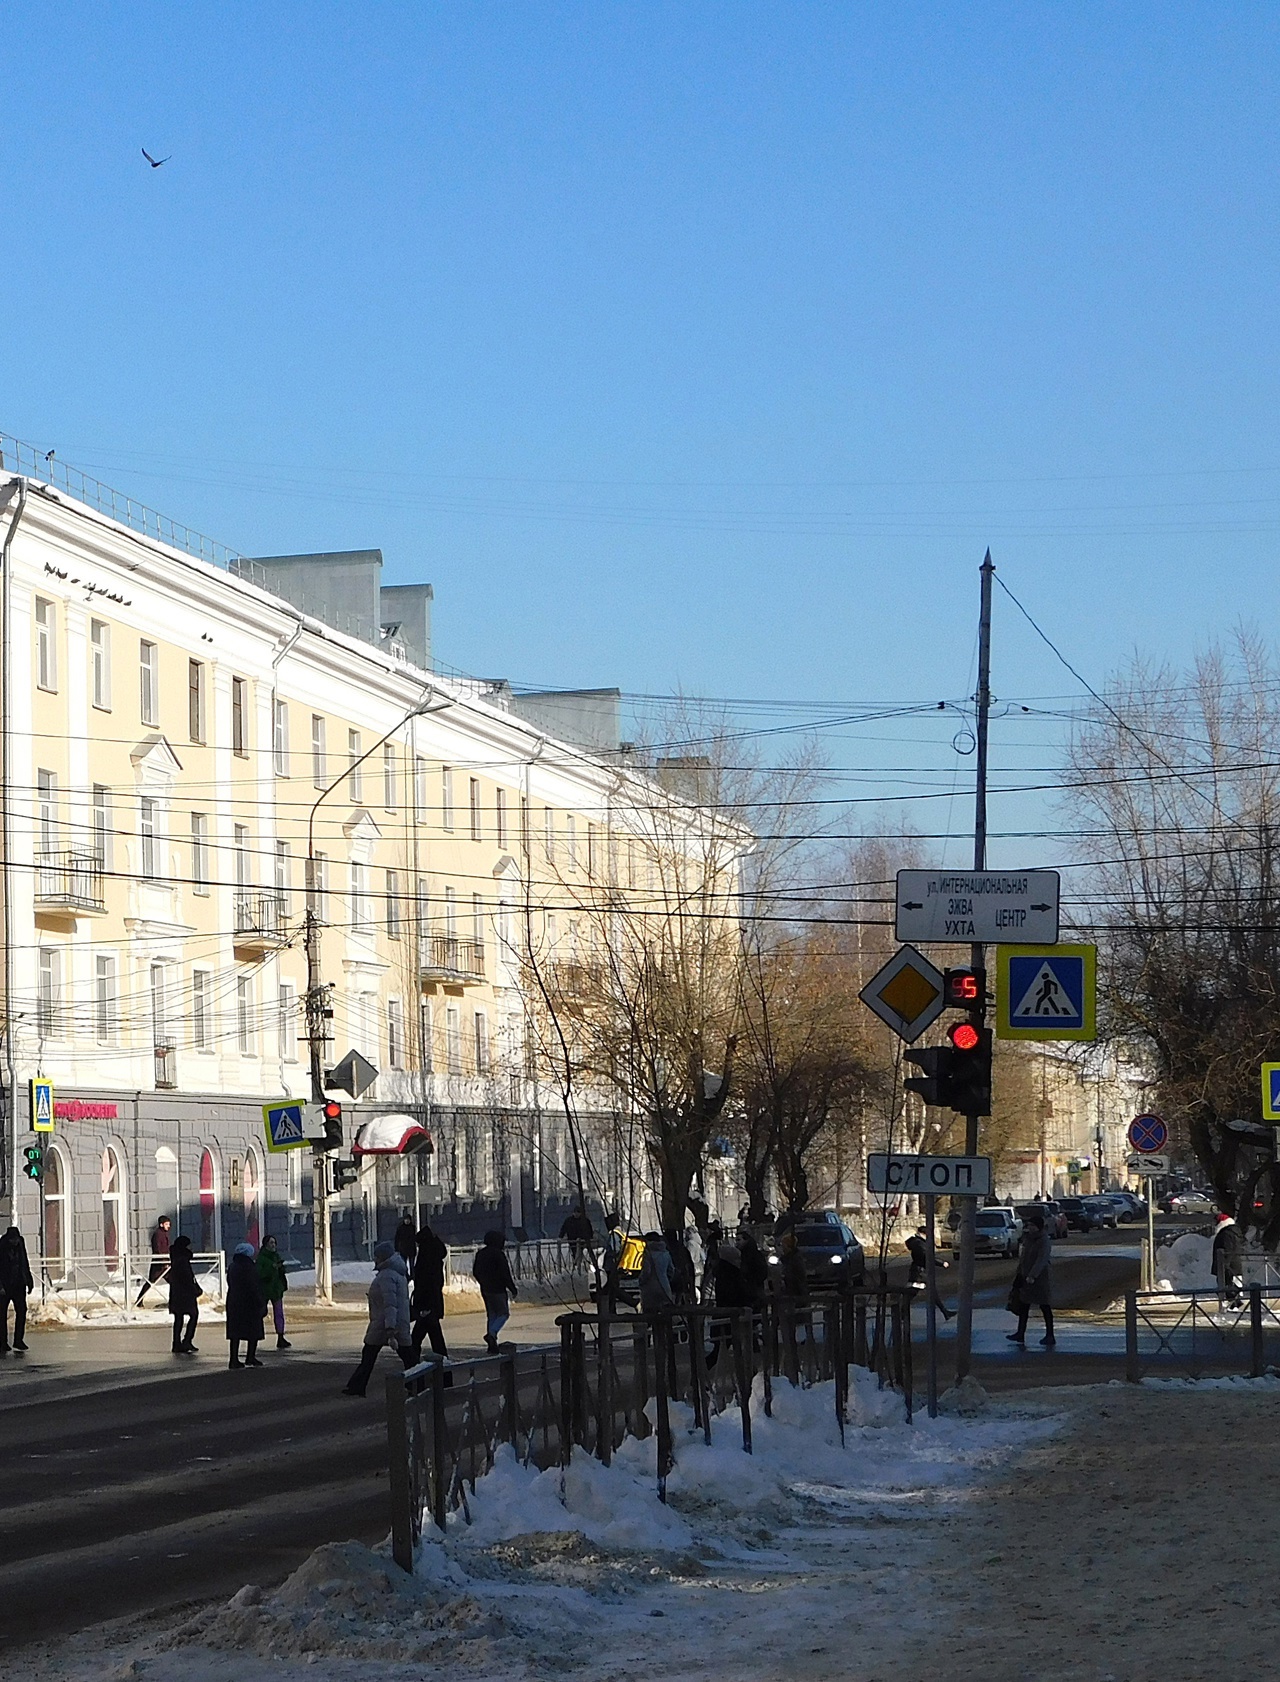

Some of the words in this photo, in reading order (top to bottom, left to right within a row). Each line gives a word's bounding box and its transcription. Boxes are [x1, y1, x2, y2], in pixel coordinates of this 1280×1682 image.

[940, 877, 1028, 895] ИНТЕРНАЦИОНАЛЬНАЯ
[947, 898, 974, 915] ЭЖВА
[944, 920, 975, 935] УХТА
[995, 909, 1027, 930] ЦЕНТР
[887, 1162, 972, 1187] СТОП
